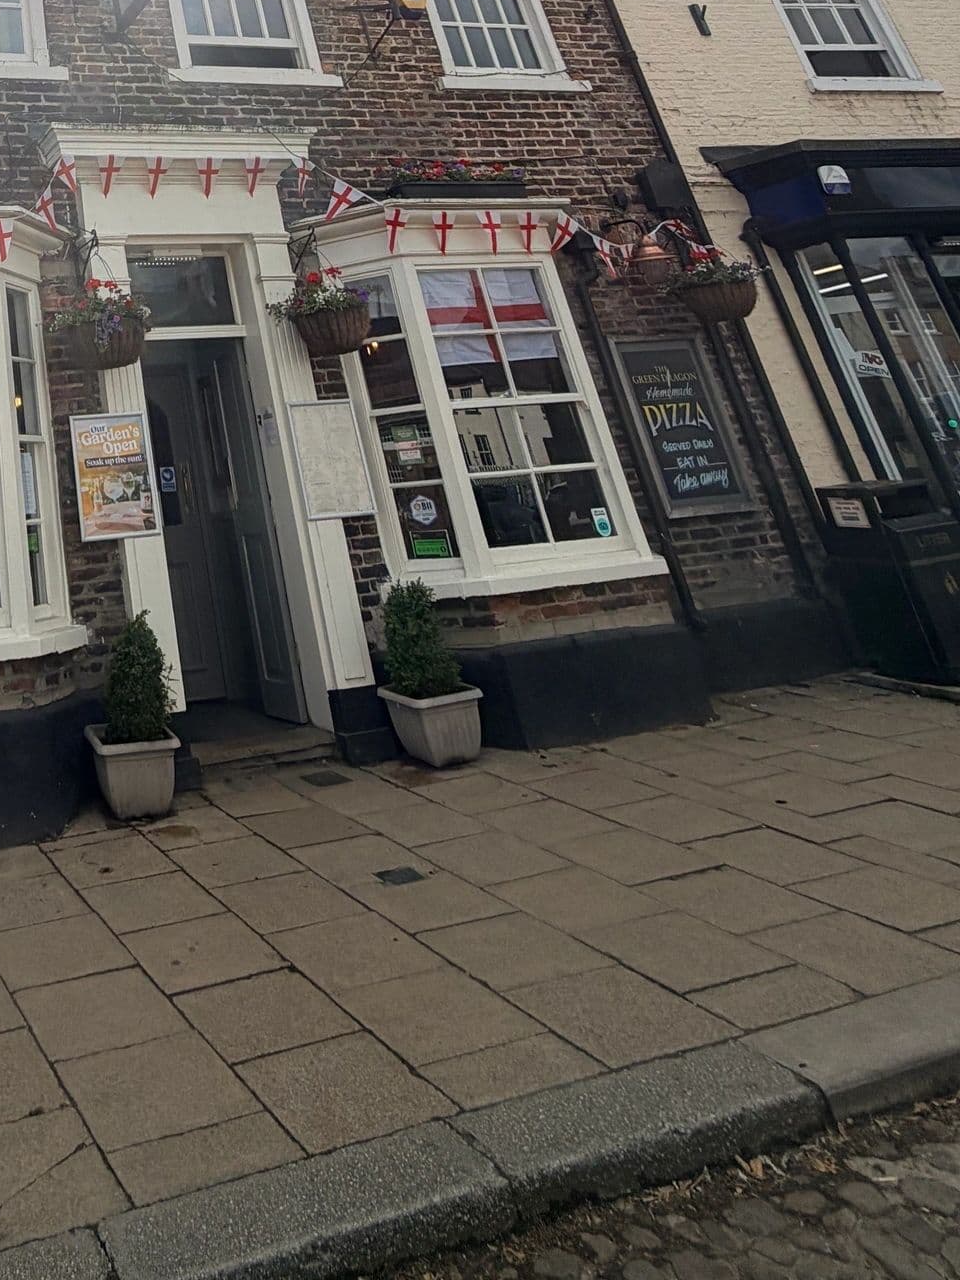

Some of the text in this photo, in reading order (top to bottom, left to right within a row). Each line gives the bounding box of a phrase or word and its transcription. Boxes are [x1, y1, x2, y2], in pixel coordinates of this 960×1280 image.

[858, 364, 889, 376] OPEN
[631, 374, 661, 385] GREEN
[642, 401, 714, 437] PIZZA
[81, 424, 140, 446] Garden's
[90, 424, 106, 434] Our
[102, 439, 138, 455] Open
[86, 457, 104, 467] Soak
[105, 458, 115, 467] up
[115, 456, 127, 465] the
[677, 455, 708, 469] EAT IN
[673, 468, 728, 493] Take away
